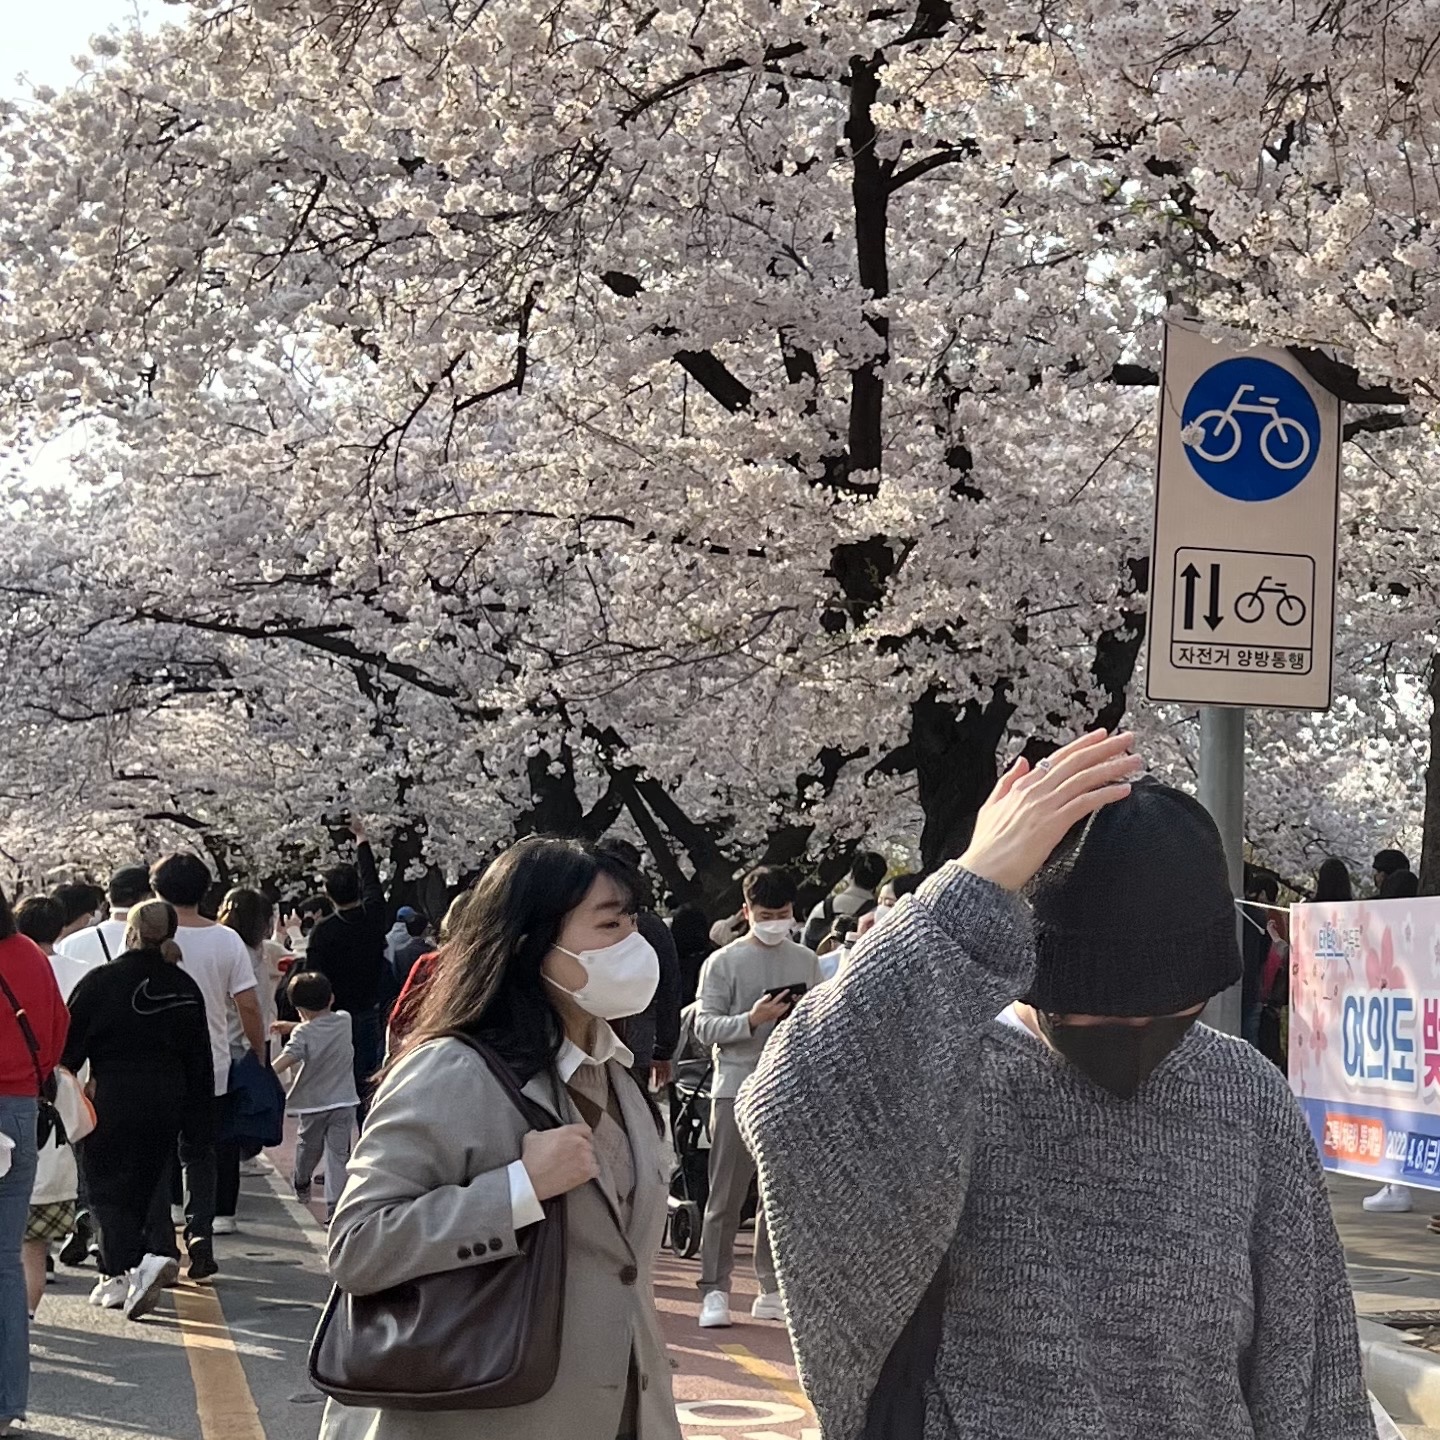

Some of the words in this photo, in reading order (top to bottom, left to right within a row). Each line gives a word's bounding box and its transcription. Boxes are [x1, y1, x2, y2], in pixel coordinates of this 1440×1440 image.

[1178, 646, 1230, 666] 자전거
[1237, 649, 1304, 670] 양방통행
[1343, 995, 1414, 1083] 여의도
